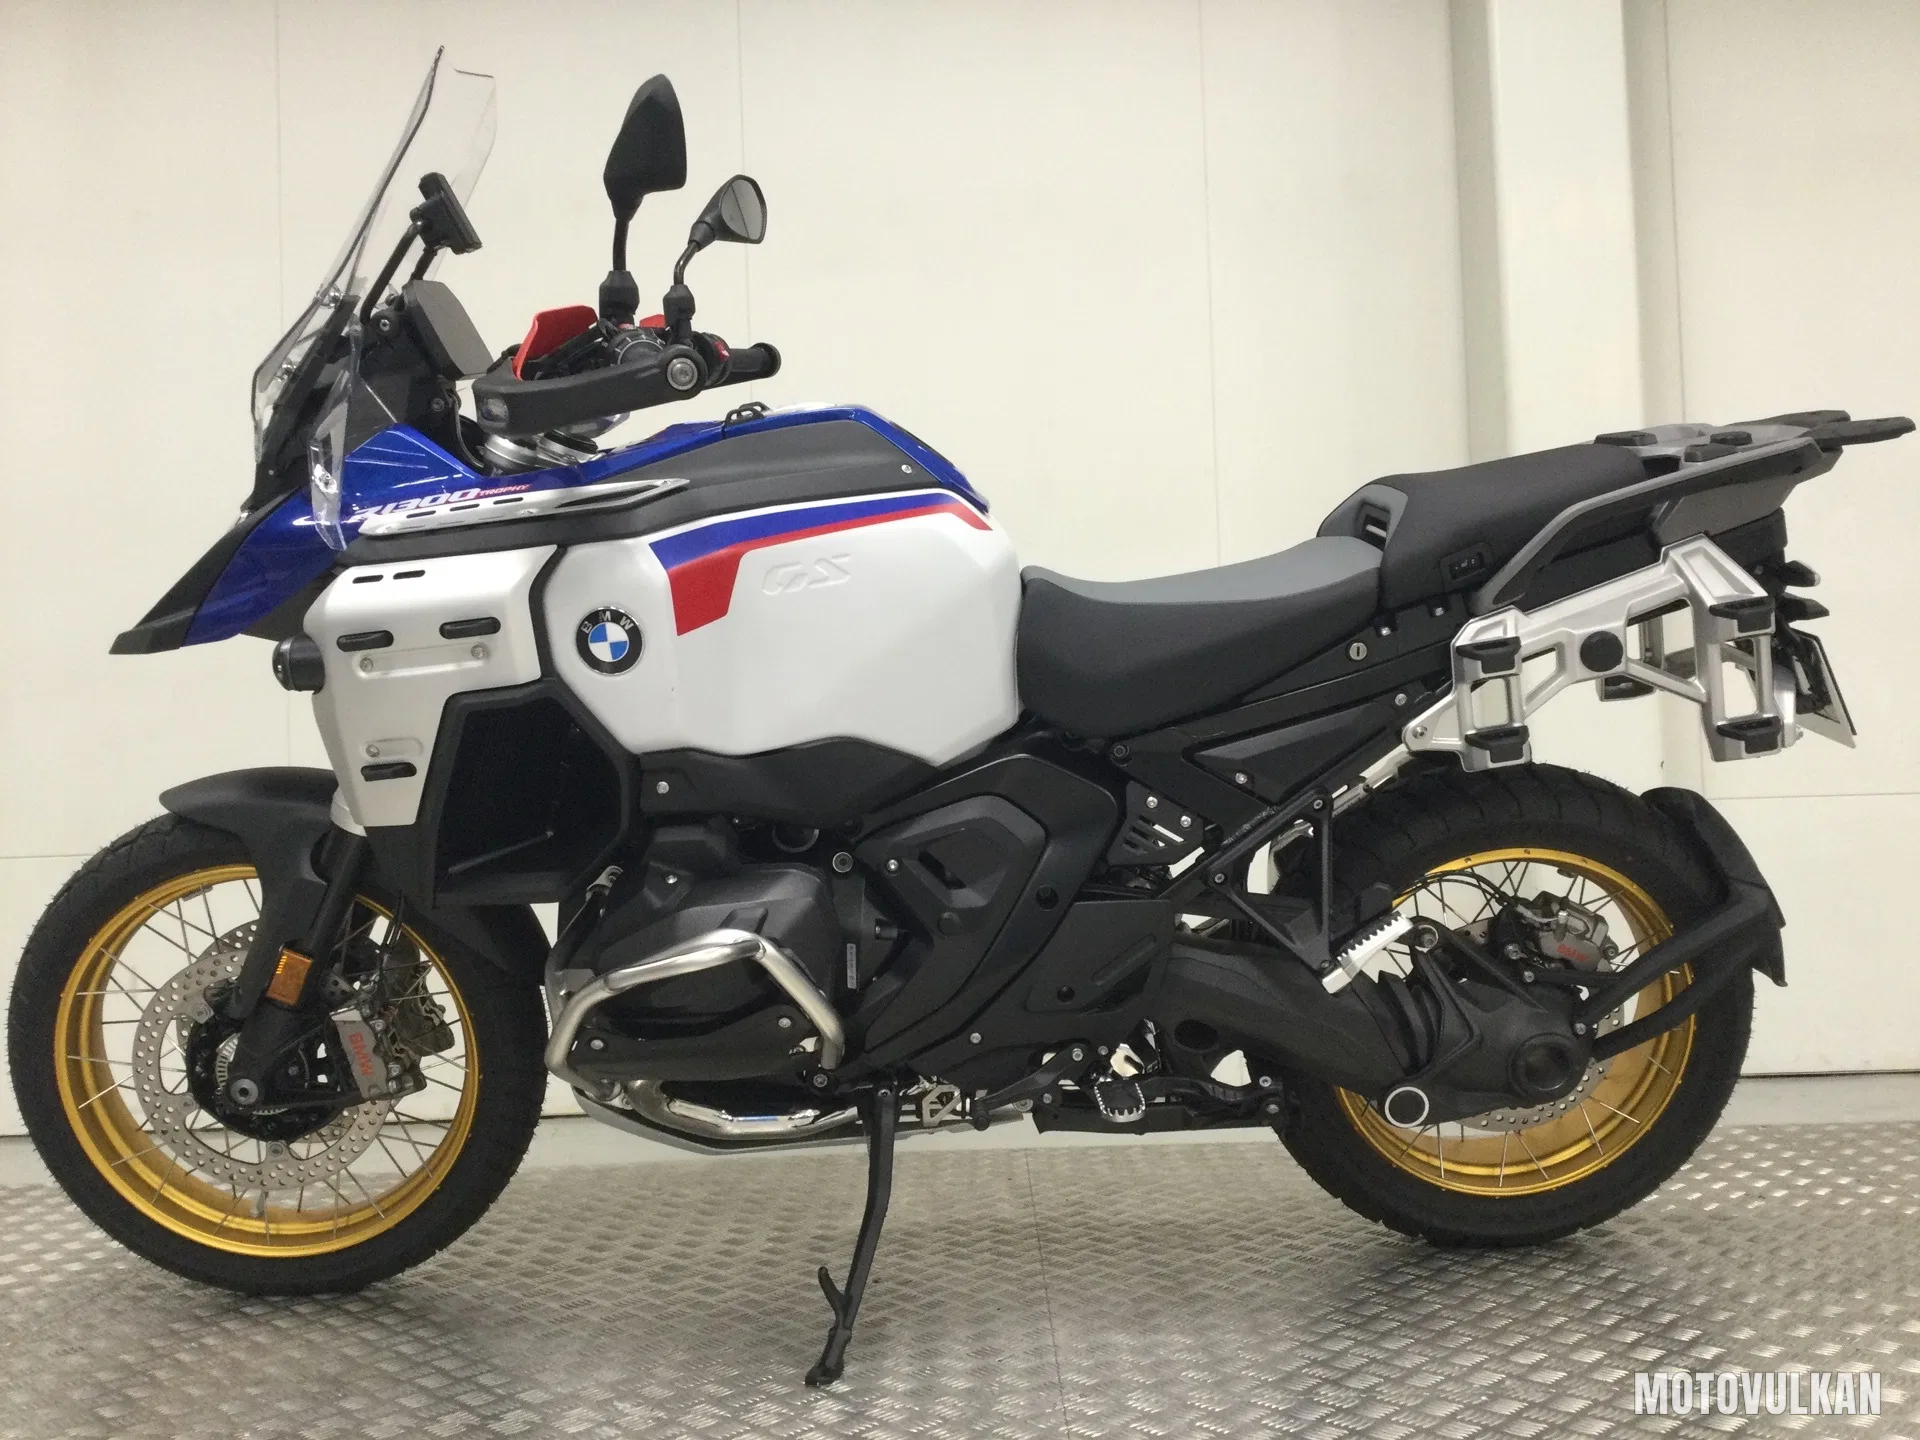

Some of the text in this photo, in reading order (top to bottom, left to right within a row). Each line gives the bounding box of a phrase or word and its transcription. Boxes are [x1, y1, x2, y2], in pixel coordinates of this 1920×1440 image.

[479, 484, 532, 497] TROPHY
[581, 610, 634, 634] BMW
[348, 1031, 375, 1078] BMW
